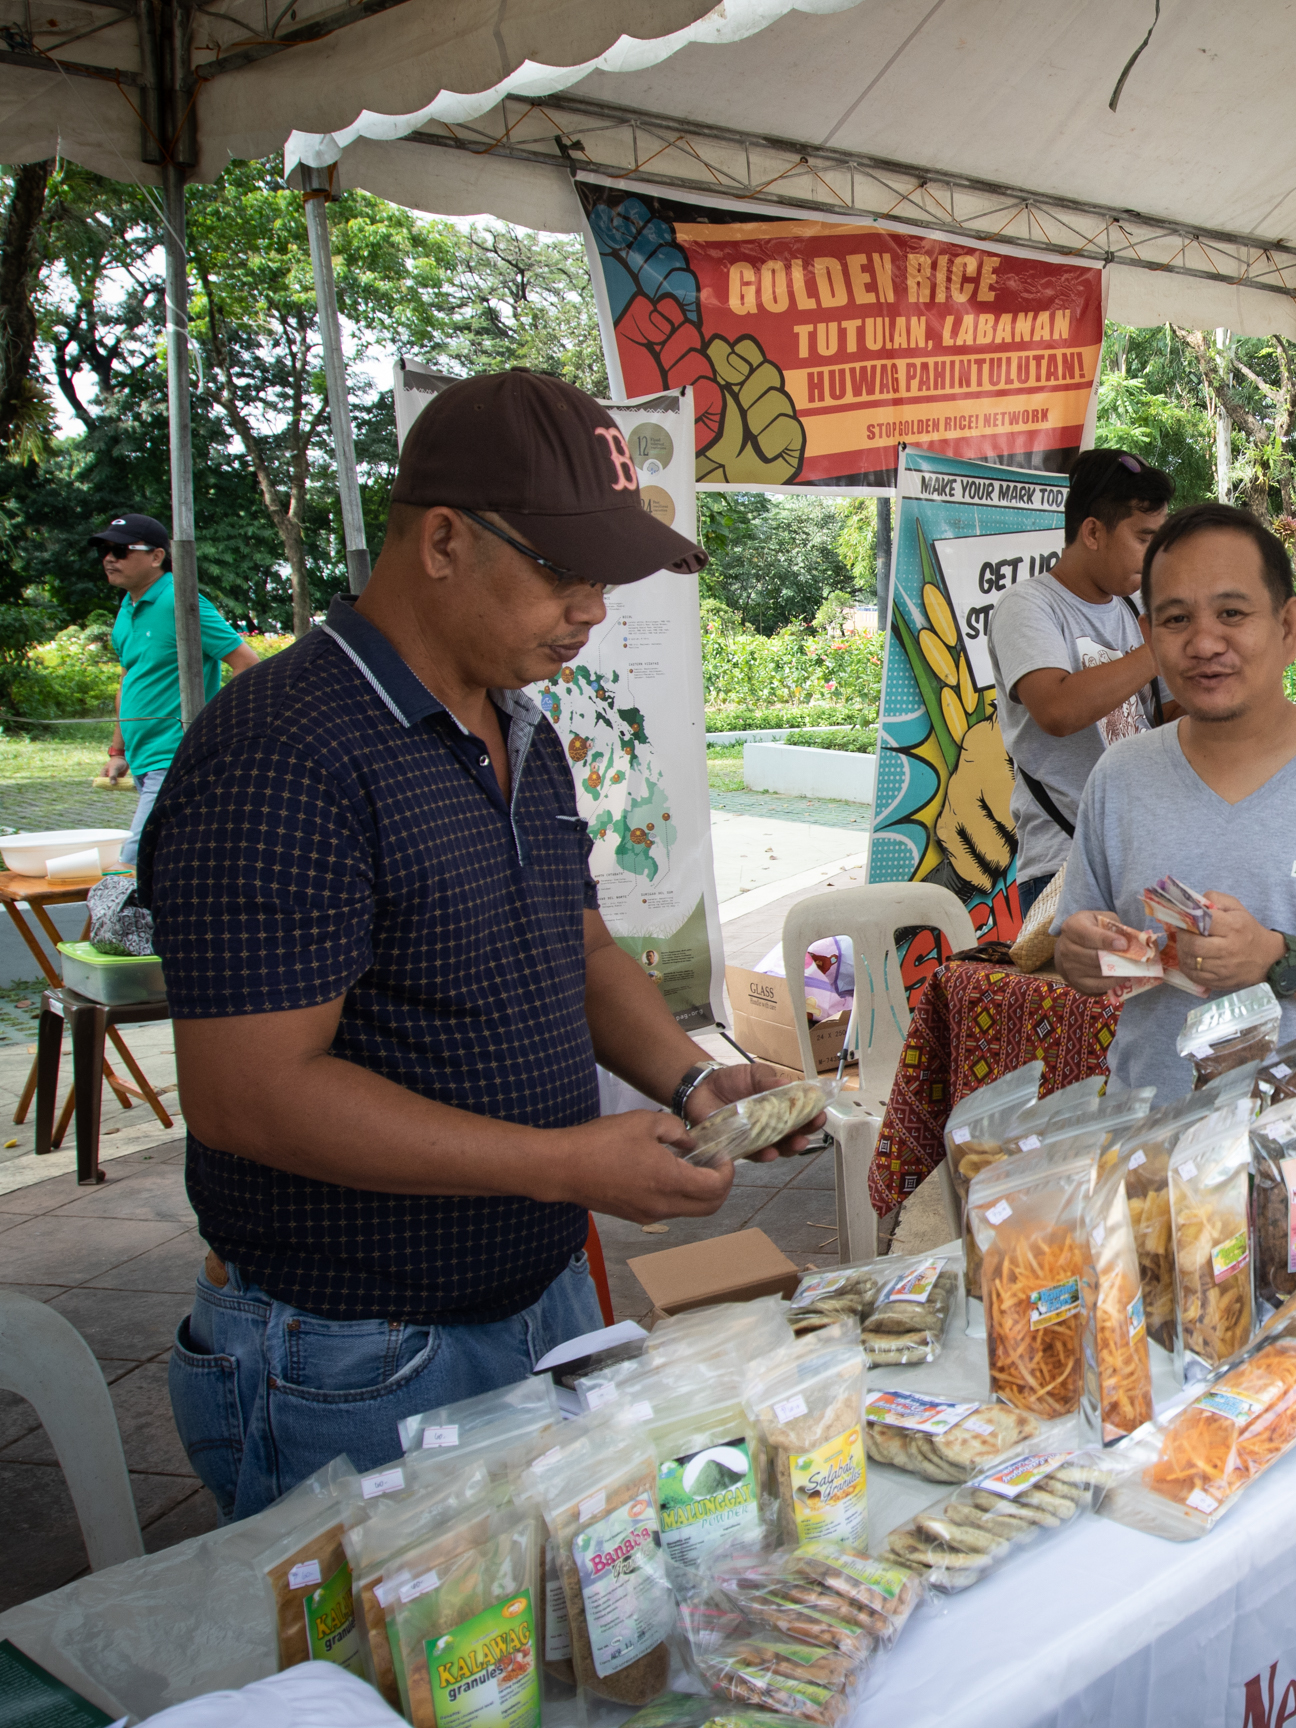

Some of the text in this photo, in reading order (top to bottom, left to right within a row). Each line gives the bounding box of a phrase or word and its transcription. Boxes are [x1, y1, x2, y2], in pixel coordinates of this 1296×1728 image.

[729, 253, 1002, 315] GOLDEN RICE
[794, 308, 1071, 360] TUTULAN, LABANAN
[807, 351, 1087, 404] HUWAG PAHINTULUTAN!
[866, 407, 1049, 441] STOP GOLDEN RICE! NETWORK
[594, 427, 638, 491] B
[637, 436, 649, 456] 12
[921, 474, 957, 498] MAKE
[961, 479, 995, 501] YOUR
[998, 484, 1036, 505] MARK
[979, 556, 1024, 594] GET
[750, 982, 774, 999] GLASS
[817, 1034, 824, 1042] 24
[805, 1454, 854, 1492] Salabat
[661, 1483, 751, 1531] MALUNGGAY
[701, 1505, 748, 1529] POWDER
[589, 1527, 651, 1577] Banaba
[437, 1620, 530, 1690] KALAWAG
[448, 1664, 504, 1702] granules
